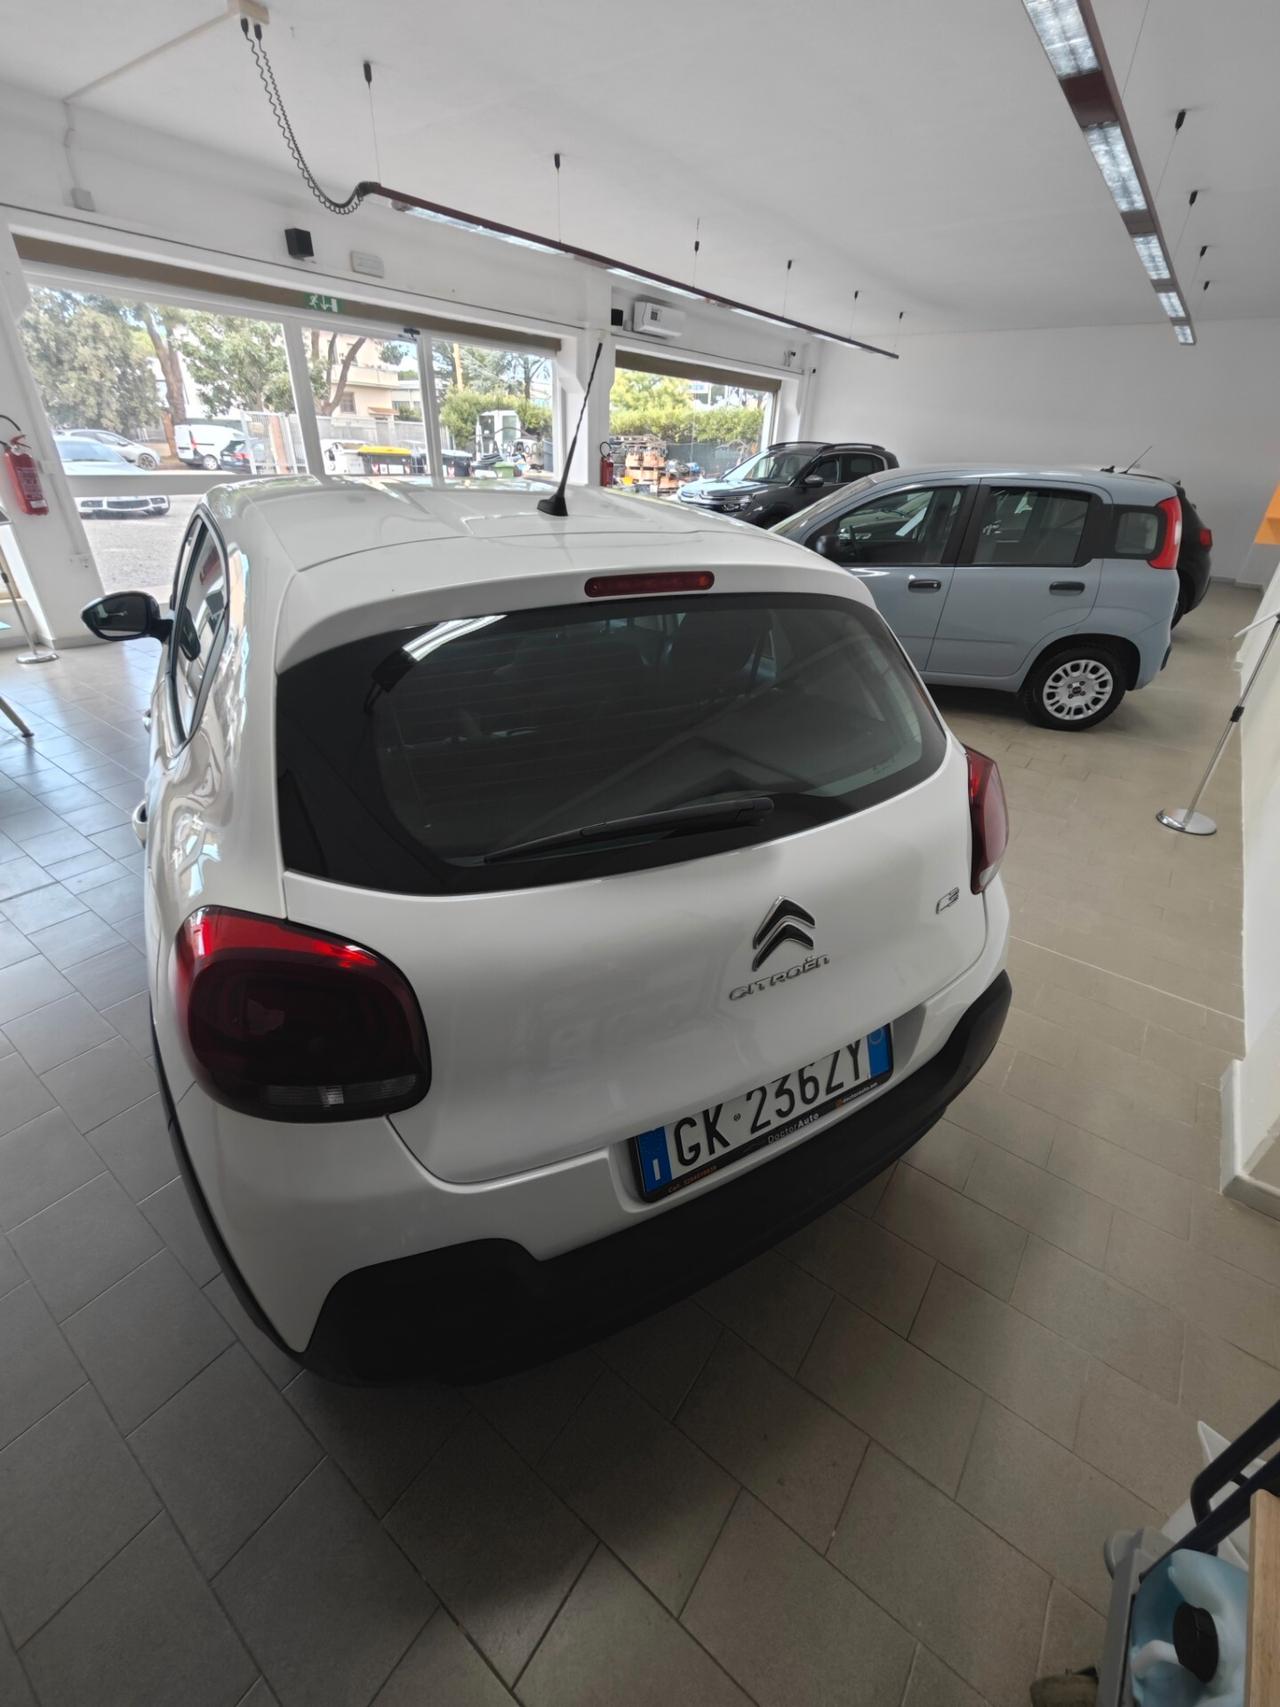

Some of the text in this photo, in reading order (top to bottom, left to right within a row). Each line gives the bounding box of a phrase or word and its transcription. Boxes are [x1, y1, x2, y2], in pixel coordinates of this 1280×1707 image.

[936, 887, 960, 914] C3
[674, 1039, 861, 1167] GK 236ZY
